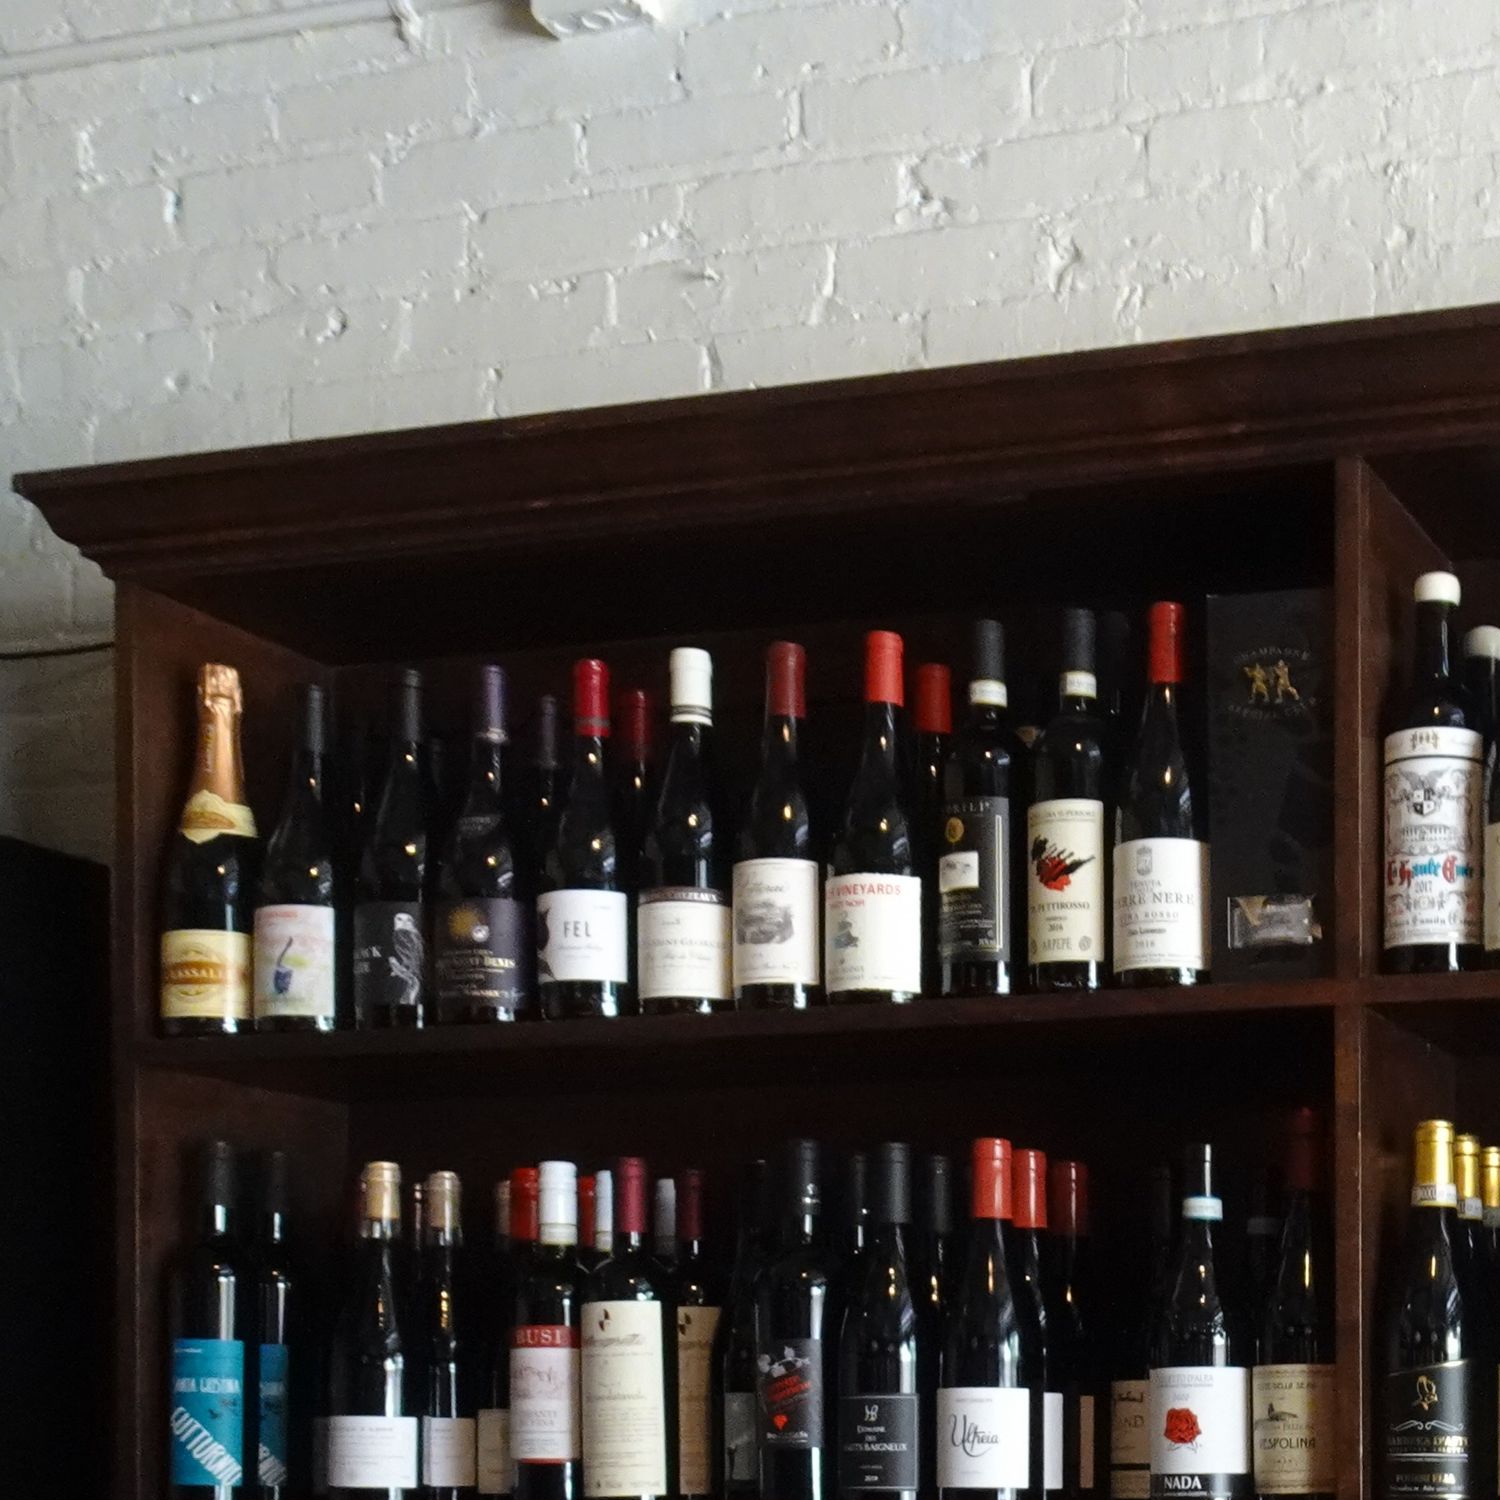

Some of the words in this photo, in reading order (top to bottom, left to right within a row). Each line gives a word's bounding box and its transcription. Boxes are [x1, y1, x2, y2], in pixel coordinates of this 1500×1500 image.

[1152, 891, 1195, 905] NERE
[563, 920, 592, 938] FEL
[1163, 1475, 1203, 1490] NADA
